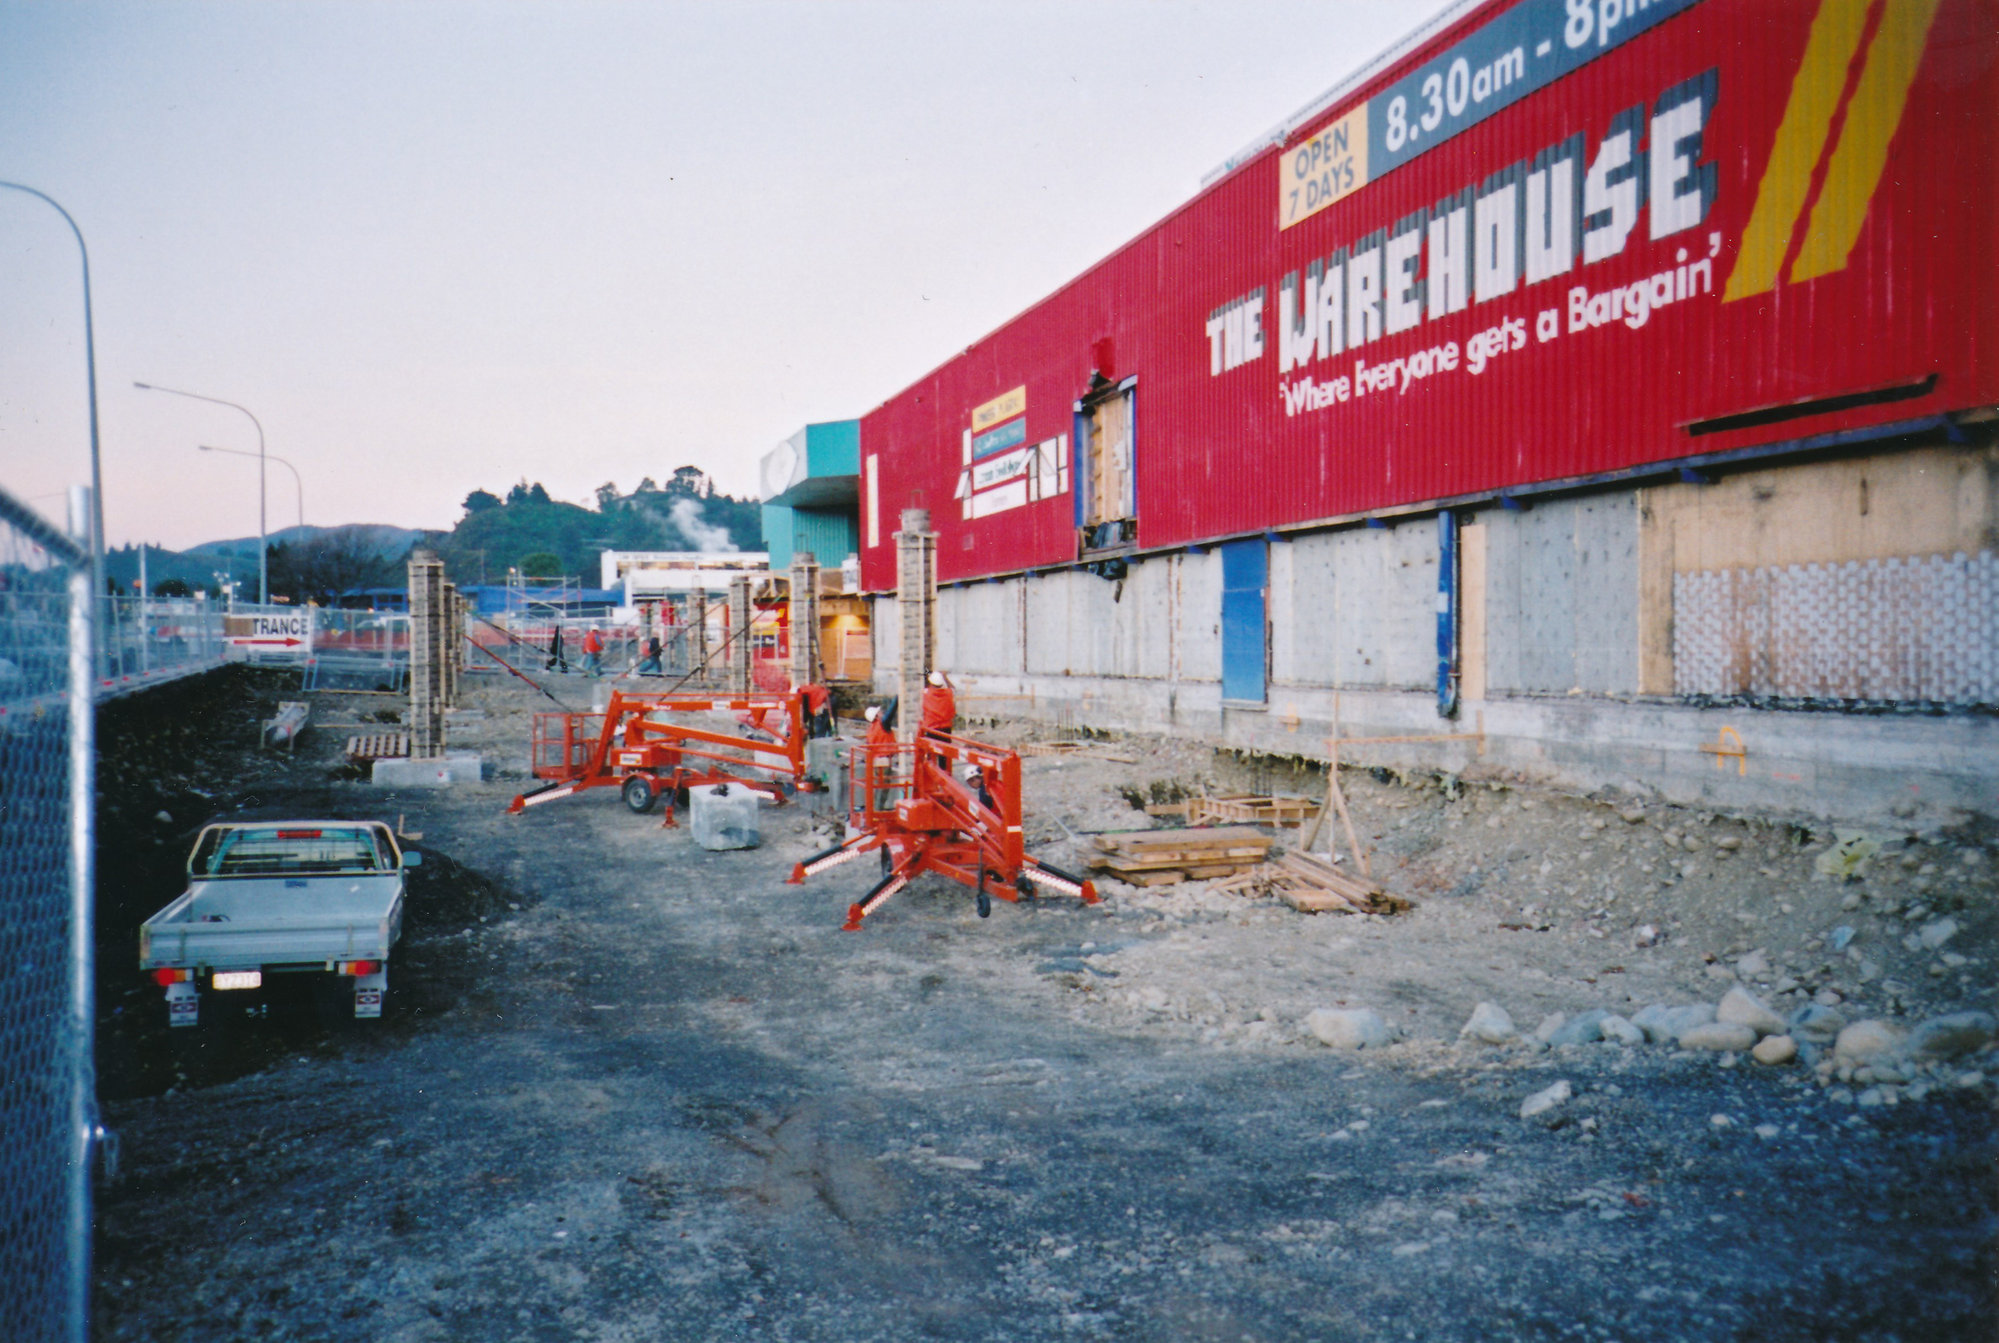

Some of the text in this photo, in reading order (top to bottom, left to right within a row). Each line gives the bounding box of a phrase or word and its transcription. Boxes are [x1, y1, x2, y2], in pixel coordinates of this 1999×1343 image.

[1385, 57, 1524, 152] 8.30am
[1564, 0, 1660, 49] 8p
[1288, 157, 1355, 220] 7 DAYS
[1294, 122, 1349, 181] OPEN
[1206, 97, 1703, 376] THE WAREHOUSE
[1355, 339, 1459, 396] Everyone
[1466, 314, 1527, 376] gets
[1536, 308, 1558, 342] a
[252, 618, 309, 636] TRANCE
